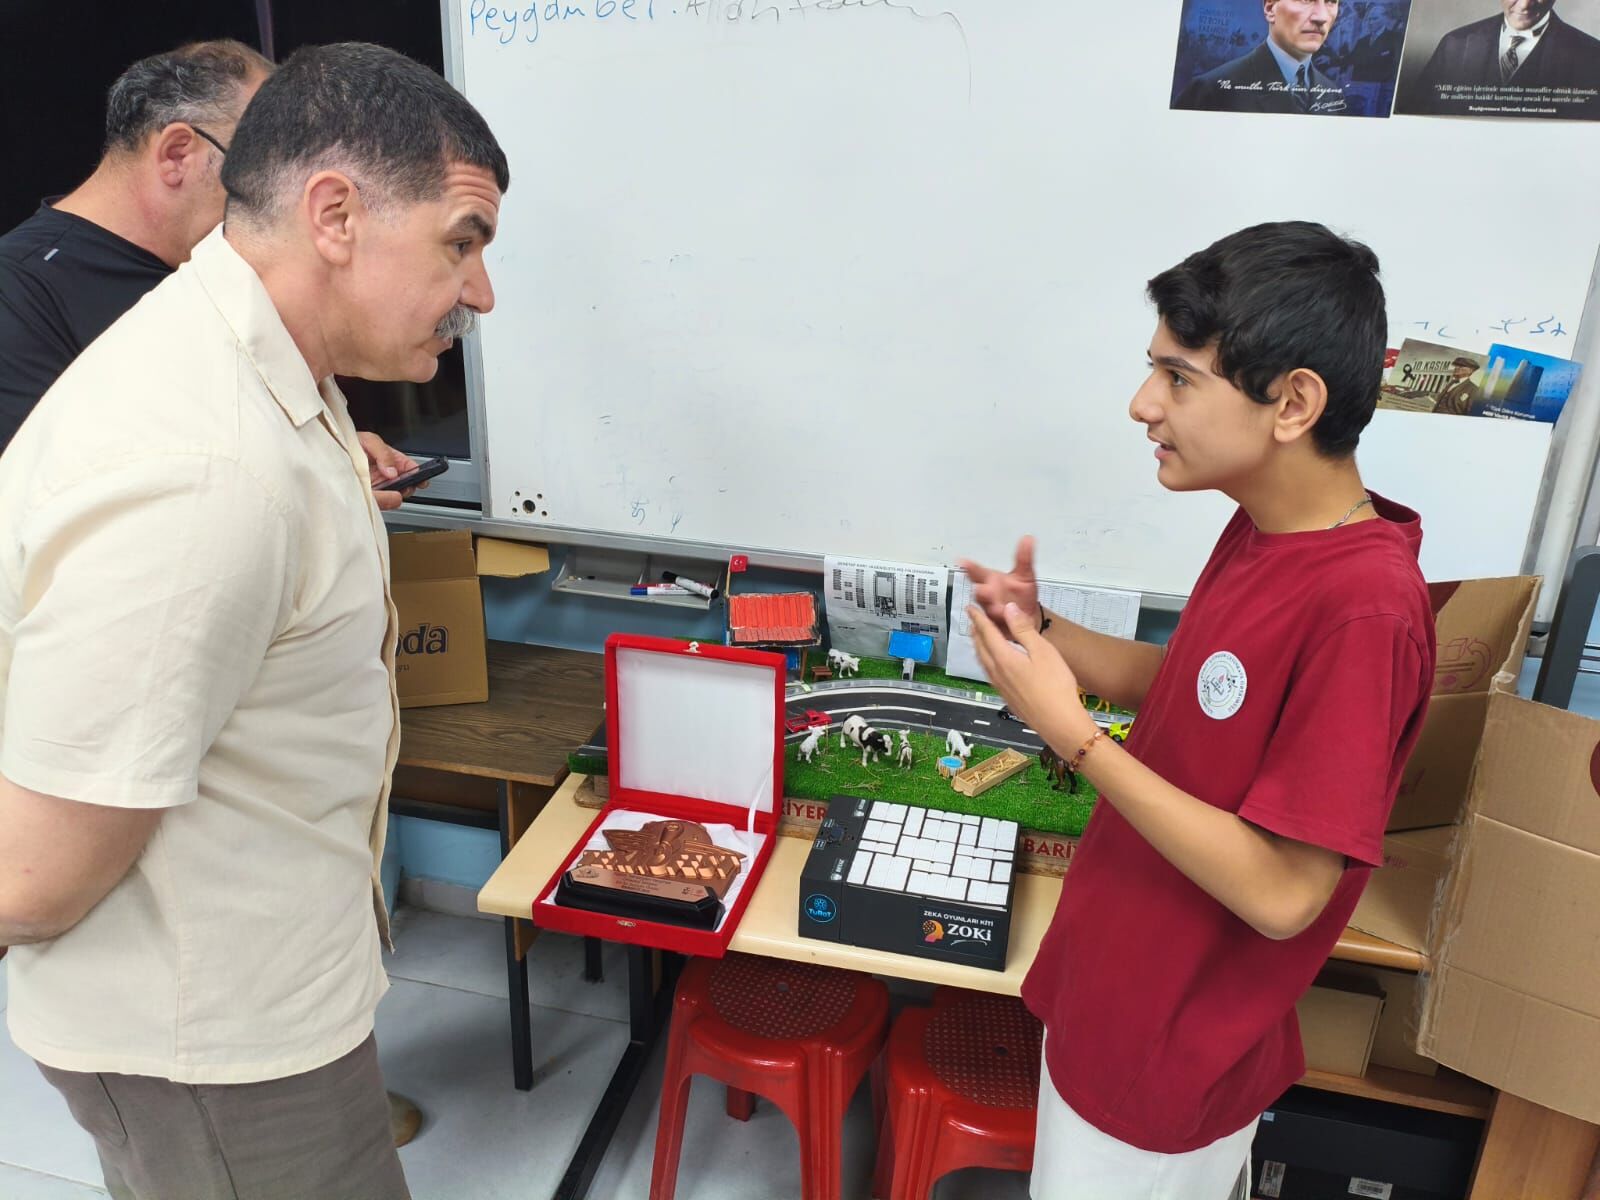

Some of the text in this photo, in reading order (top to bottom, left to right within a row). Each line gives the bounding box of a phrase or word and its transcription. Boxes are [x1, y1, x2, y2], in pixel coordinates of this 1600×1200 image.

[1234, 81, 1263, 90] mutlu
[1413, 361, 1451, 371] 10 KASIM
[395, 623, 447, 656] da
[1023, 838, 1076, 859] BARİ
[924, 910, 942, 918] ZEKA
[943, 913, 978, 924] OYUNLARI
